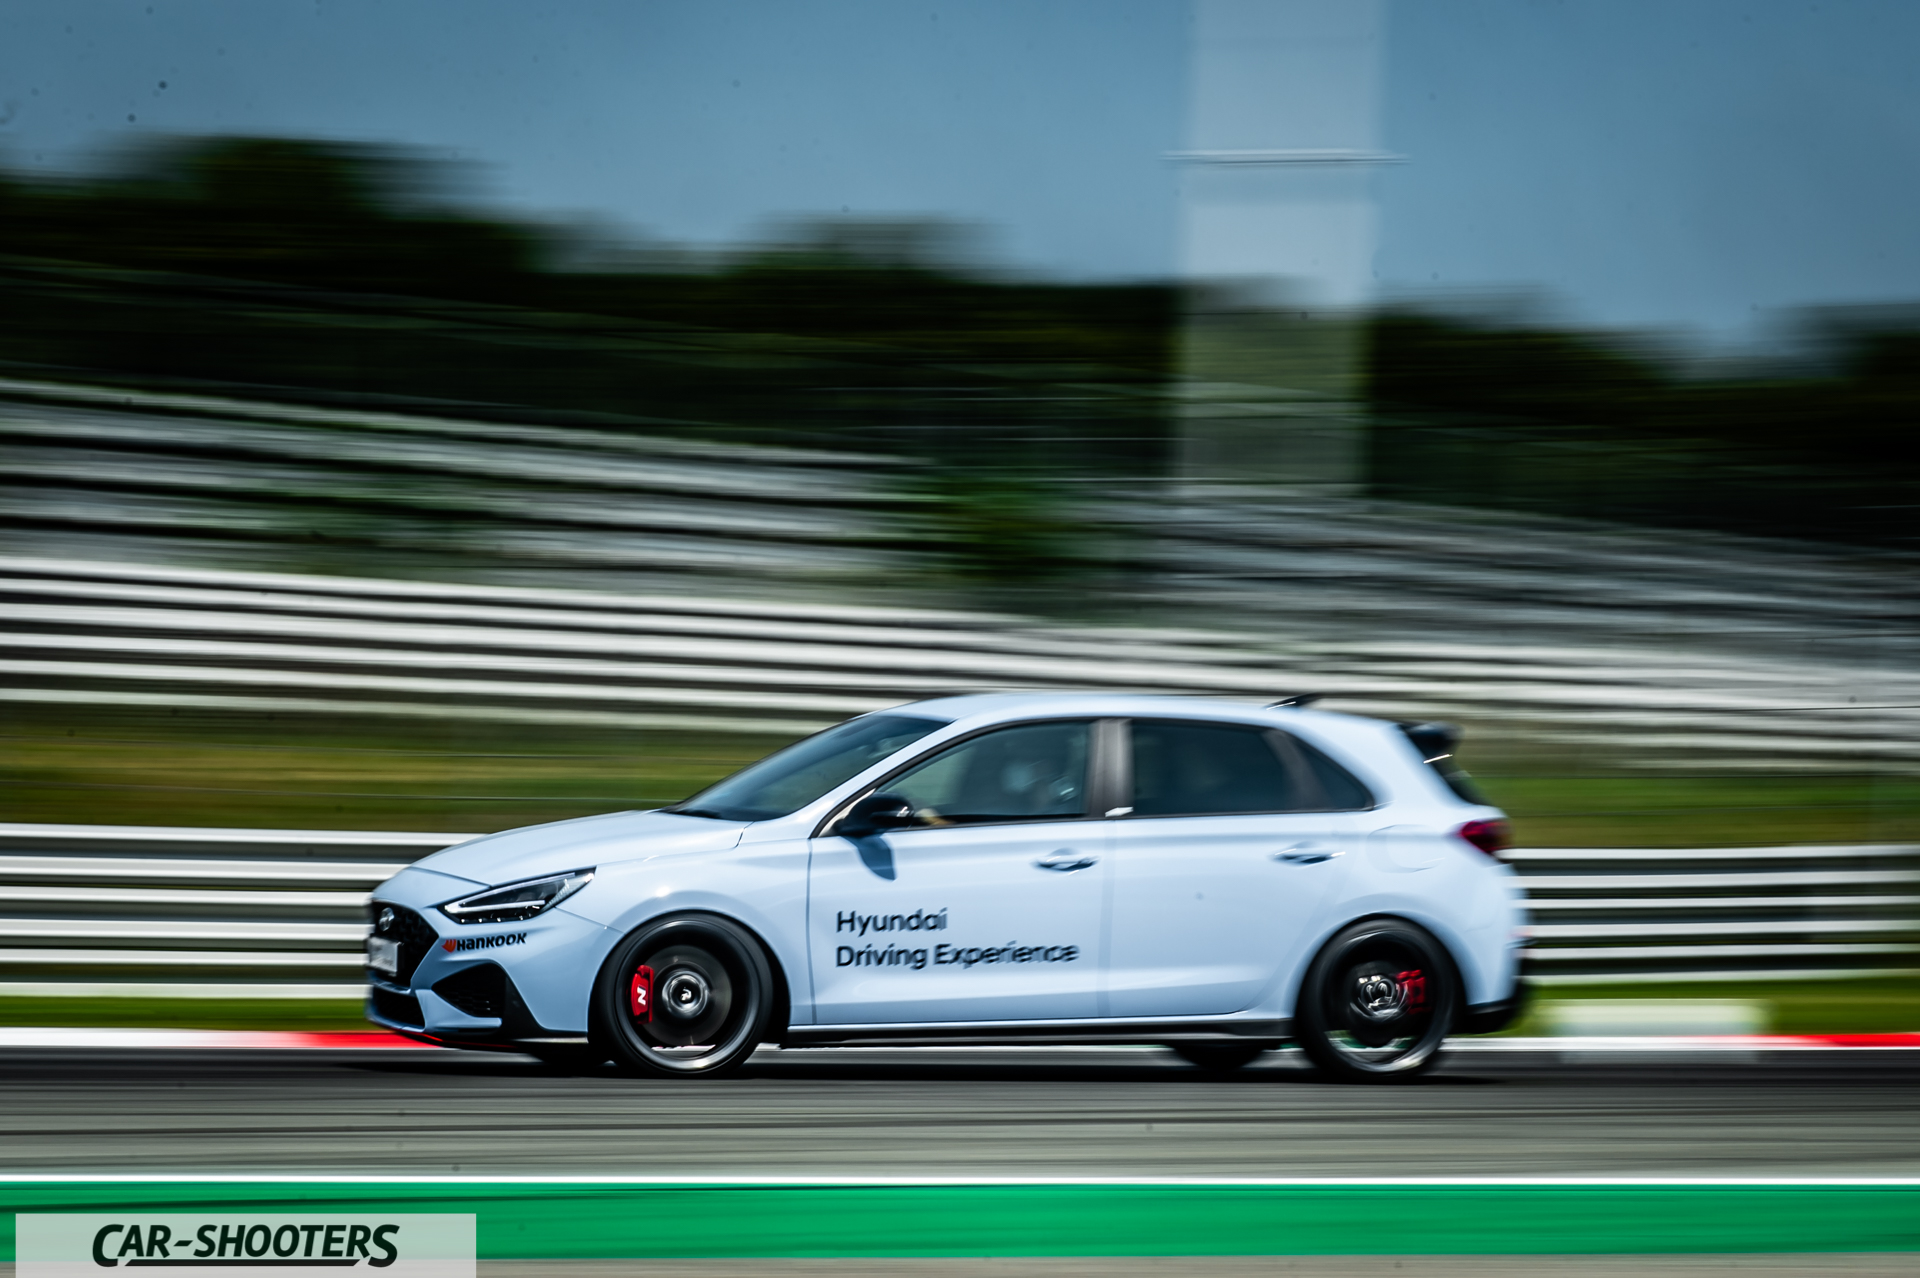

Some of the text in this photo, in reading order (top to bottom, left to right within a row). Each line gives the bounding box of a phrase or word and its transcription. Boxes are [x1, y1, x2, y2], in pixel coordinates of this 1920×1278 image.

[836, 907, 948, 937] Hyundai
[836, 940, 1080, 970] Driving Experience
